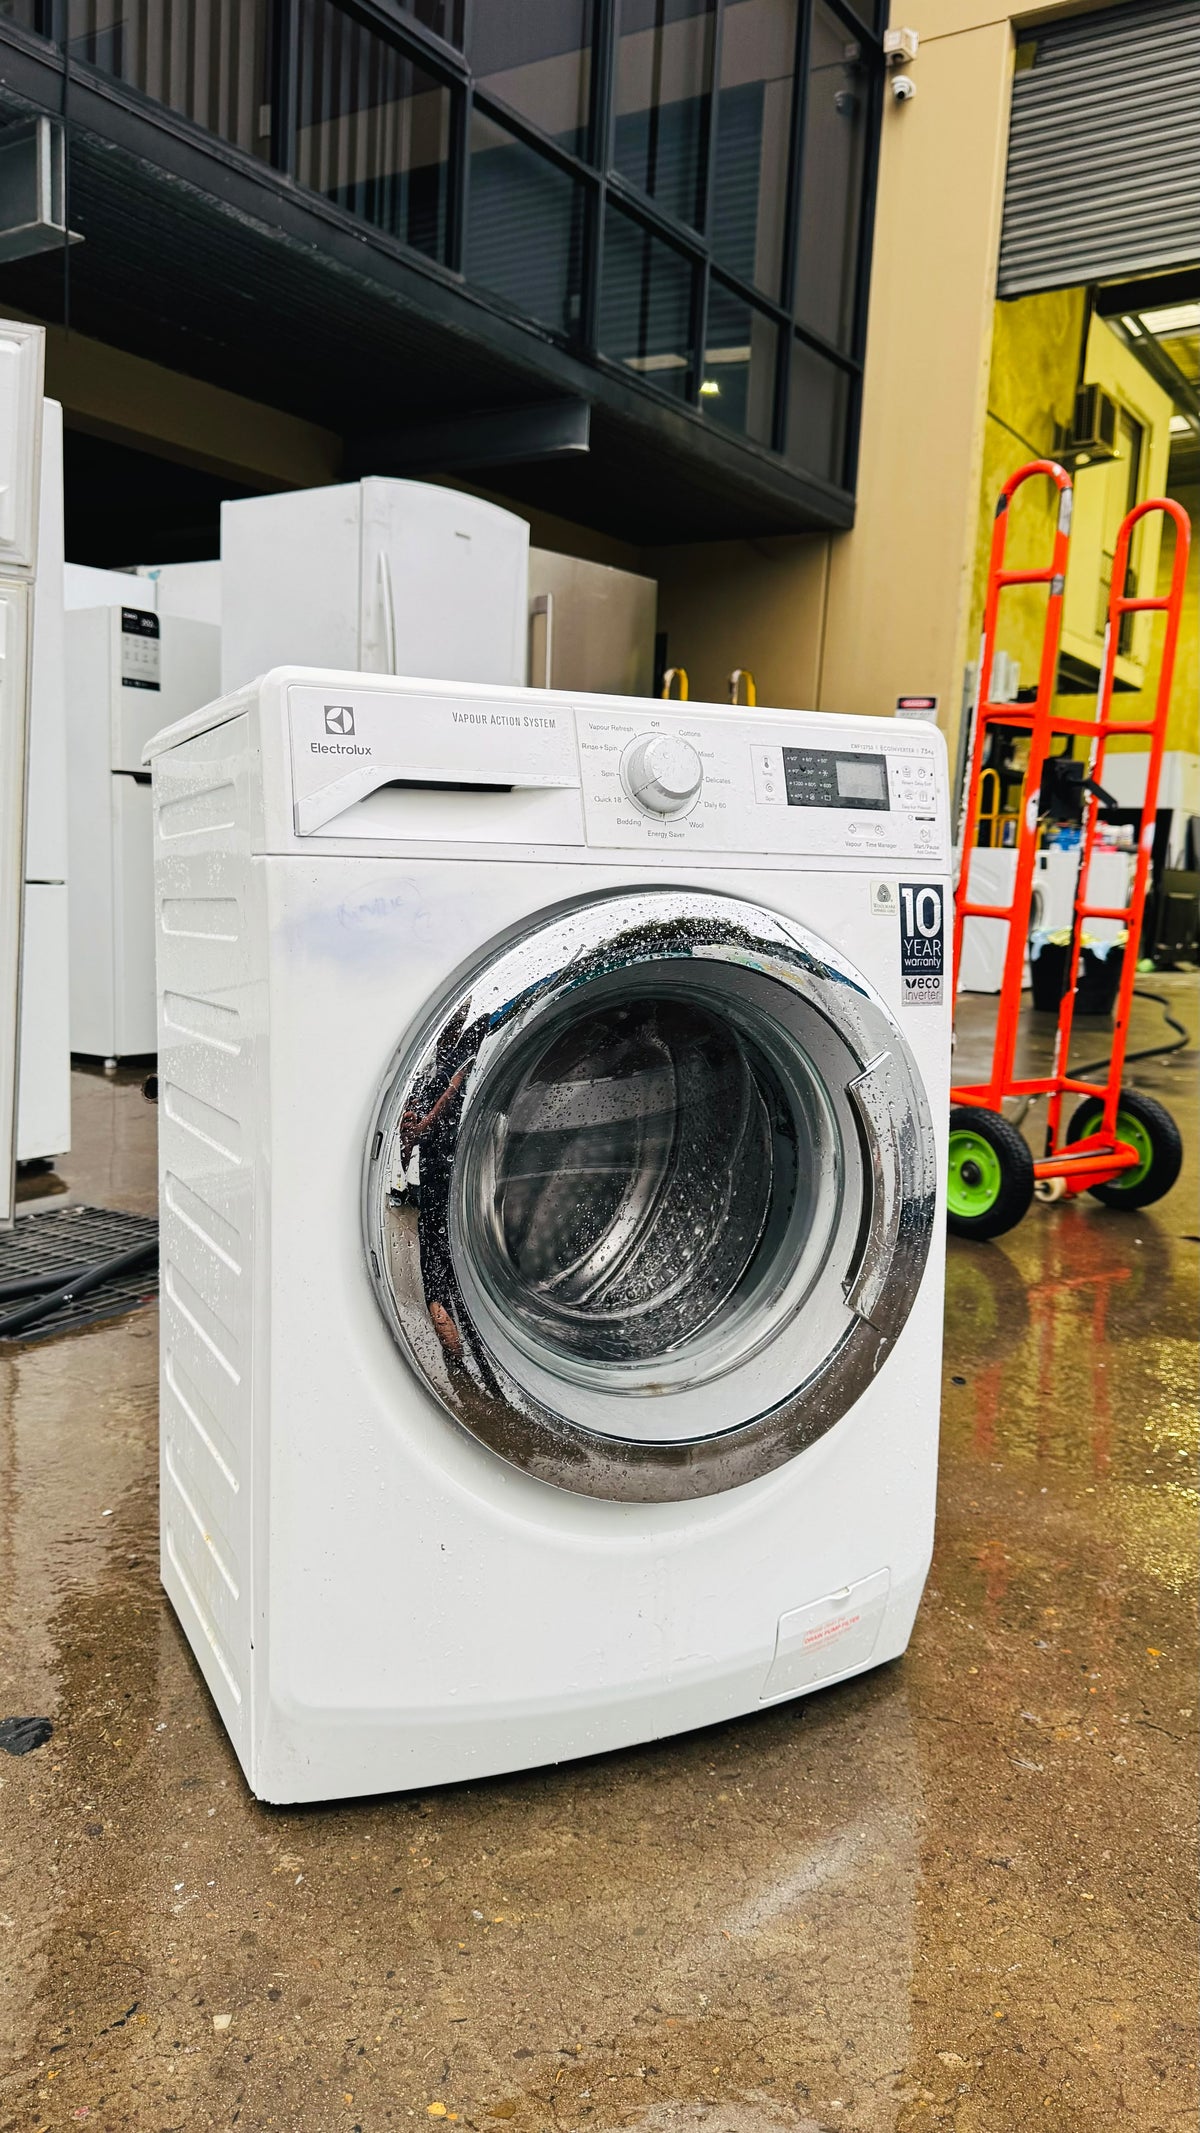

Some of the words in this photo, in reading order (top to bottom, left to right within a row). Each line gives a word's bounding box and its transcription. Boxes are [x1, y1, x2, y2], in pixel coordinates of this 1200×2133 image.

[452, 712, 487, 724] VAPOUR
[490, 714, 521, 726] ACTION
[523, 716, 556, 728] SYSTEM
[310, 742, 372, 755] Electrolux
[617, 818, 641, 826] Bedding
[648, 830, 667, 838] Energy
[902, 888, 941, 938] 10
[904, 940, 941, 956] YEAR
[904, 957, 941, 968] warranty
[906, 989, 939, 1000] inverter
